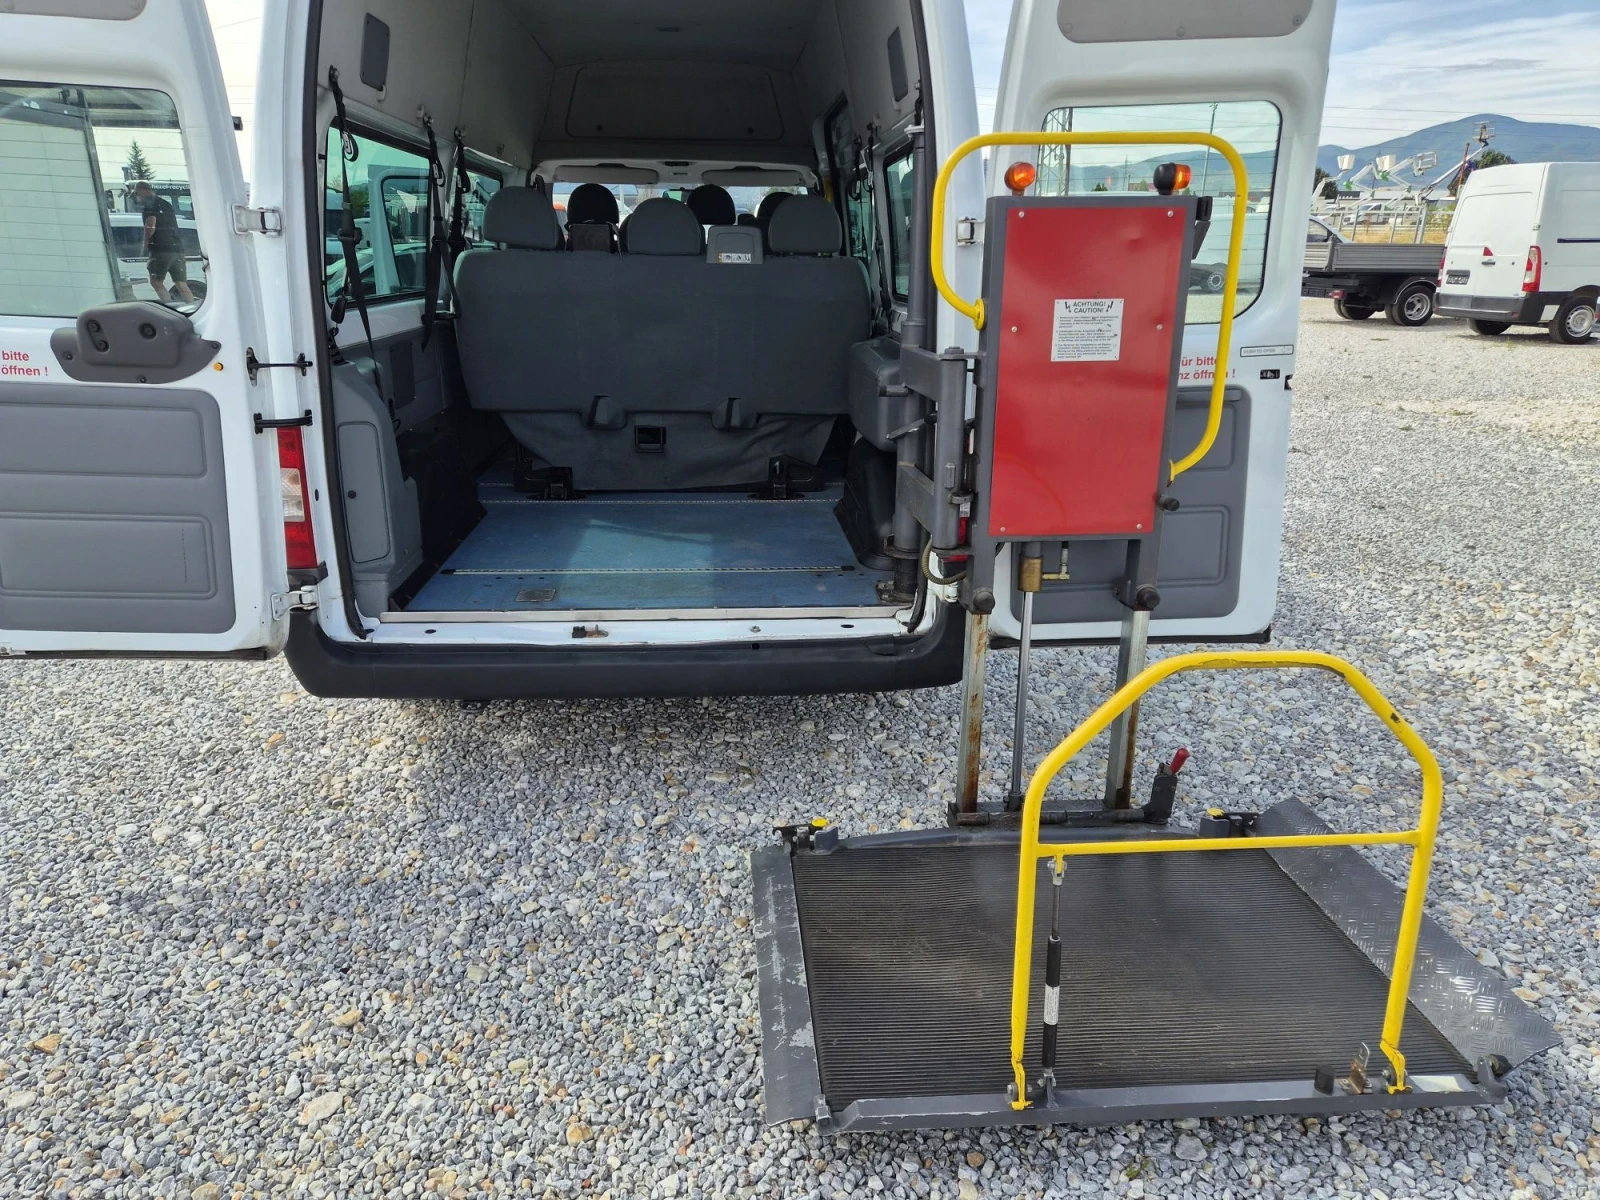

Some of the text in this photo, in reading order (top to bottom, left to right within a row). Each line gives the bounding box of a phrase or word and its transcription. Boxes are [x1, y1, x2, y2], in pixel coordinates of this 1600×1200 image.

[2, 350, 29, 361] bitte
[1181, 356, 1193, 366] ür
[1, 364, 48, 376] öffnen !
